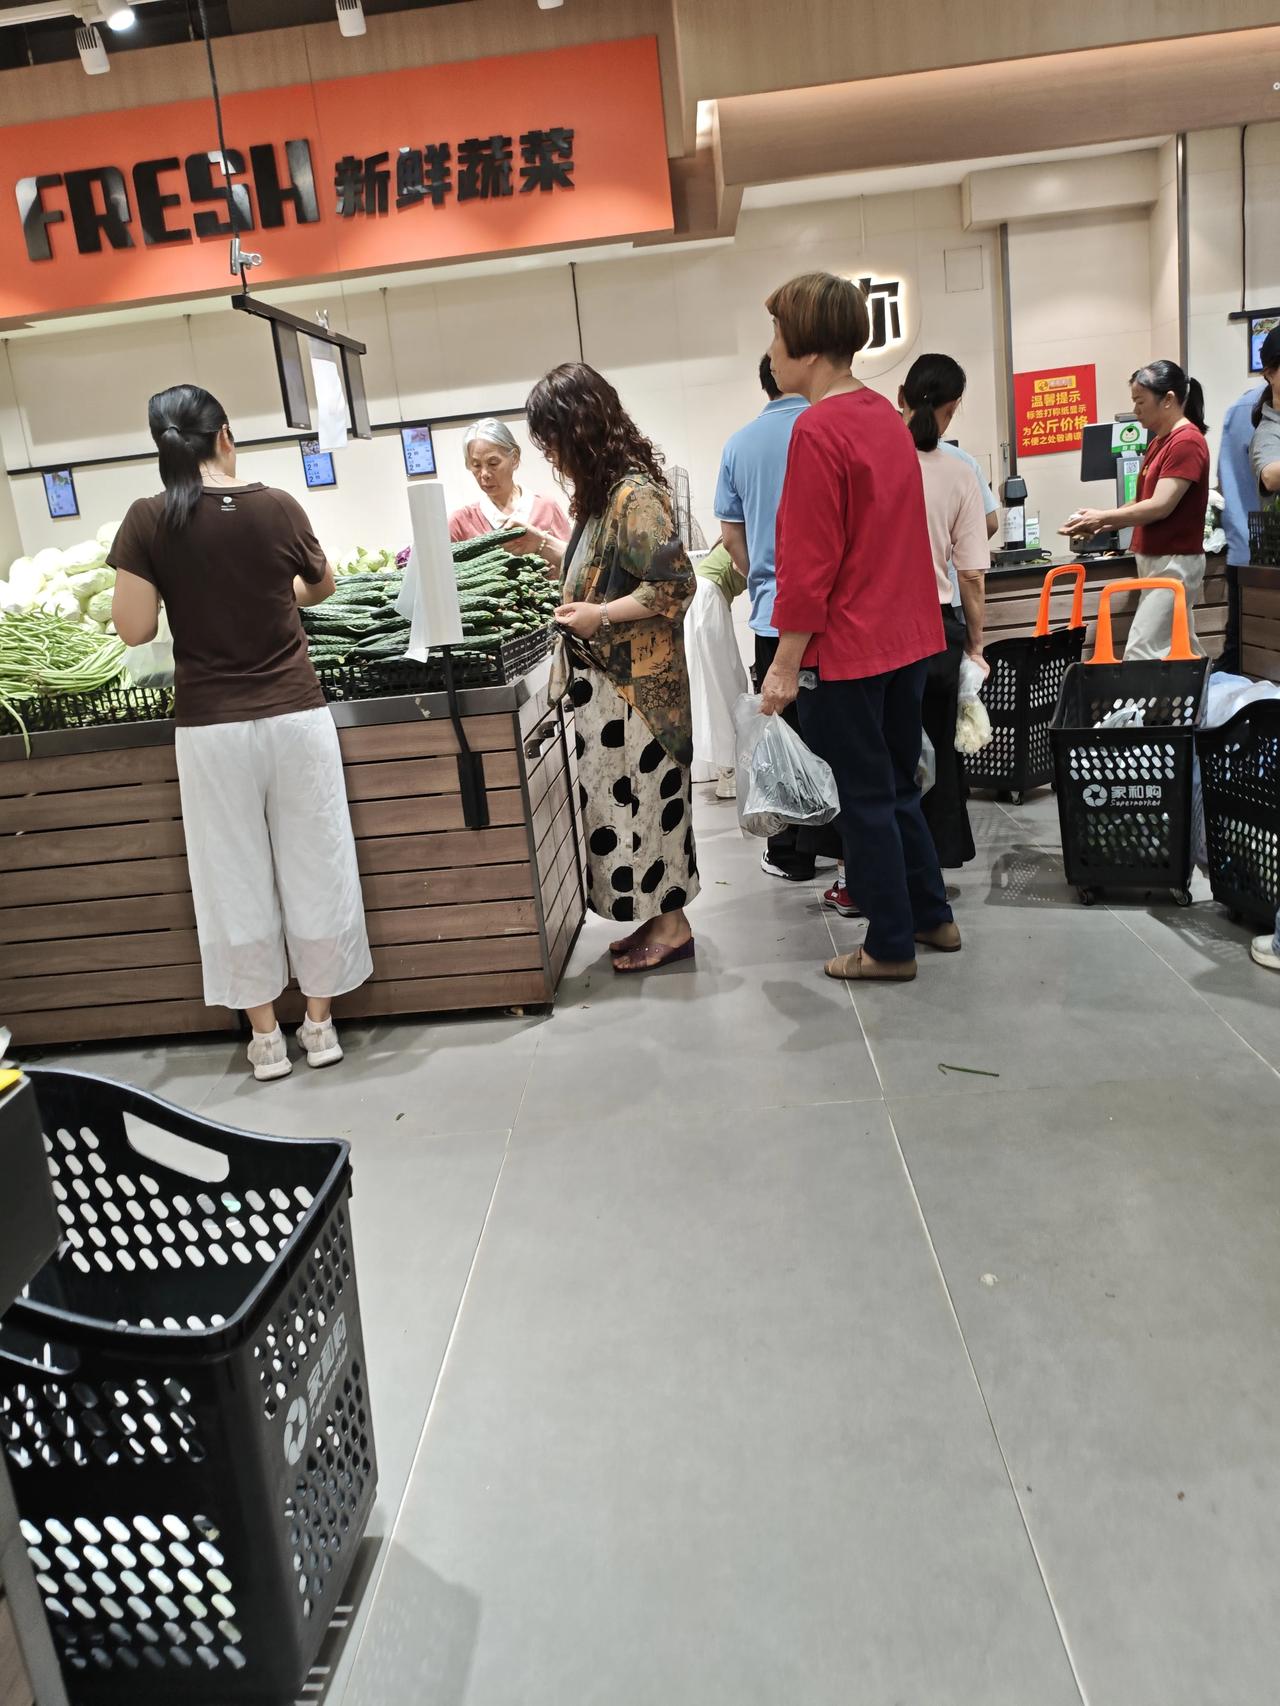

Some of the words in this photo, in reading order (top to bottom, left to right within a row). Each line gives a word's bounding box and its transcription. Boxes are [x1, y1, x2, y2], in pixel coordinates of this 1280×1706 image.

[15, 139, 320, 261] FRESH
[334, 127, 575, 217] 新鲜蔬菜
[1031, 391, 1081, 408] 温馨提示
[1023, 415, 1088, 436] 为公斤价格
[1111, 785, 1162, 798] 家和购
